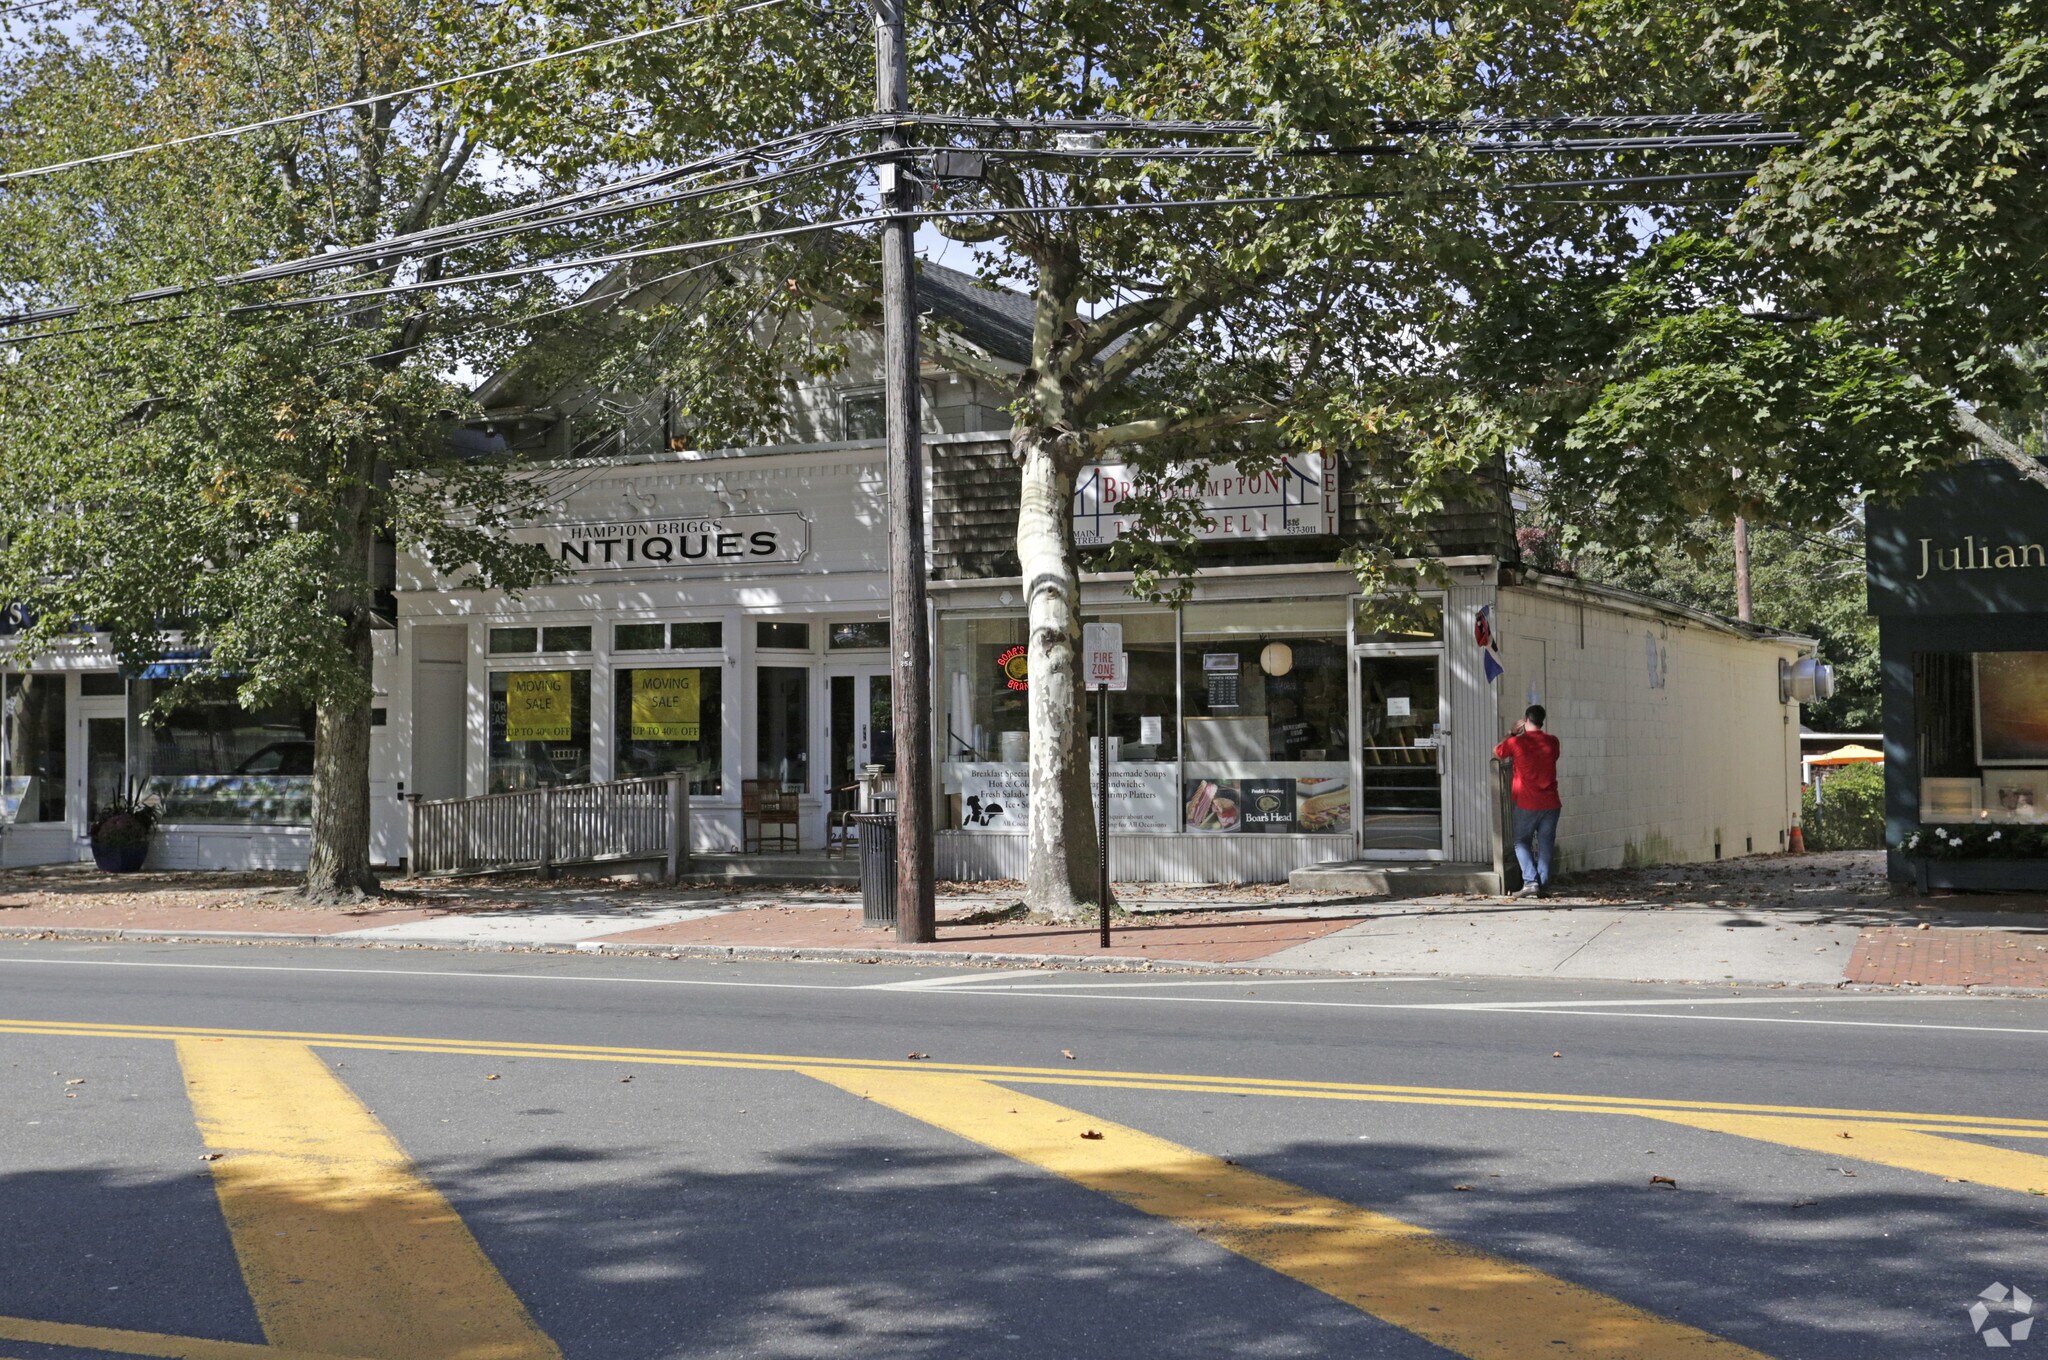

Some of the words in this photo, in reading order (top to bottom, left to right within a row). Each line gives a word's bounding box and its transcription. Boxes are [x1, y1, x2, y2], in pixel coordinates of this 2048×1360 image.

[1323, 453, 1336, 535] DELI
[571, 521, 648, 539] HAMPTON
[657, 520, 722, 535] BRIGGS
[1205, 514, 1268, 534] DELI
[1286, 526, 1317, 535] 537-3011
[1916, 535, 2047, 580] Julian
[1093, 652, 1113, 663] FIRE
[1092, 664, 1115, 675] ZONE
[516, 680, 561, 692] MOVING
[642, 678, 689, 690] MOVING
[1007, 680, 1029, 691] BRAN
[525, 699, 551, 710] SALE
[652, 696, 679, 707] SALE
[507, 728, 520, 736] UP
[521, 728, 534, 736] TO
[553, 727, 571, 736] OFF
[632, 727, 645, 735] UP
[646, 727, 659, 735] TO
[681, 727, 699, 735] OFF
[971, 769, 1003, 778] Breakfast
[1108, 769, 1142, 778] omemade
[1144, 769, 1167, 780] Soups
[988, 780, 1003, 788] Hot
[981, 790, 1000, 798] Fresh
[1002, 790, 1025, 798] Salads
[1129, 791, 1156, 799] Platters
[1245, 812, 1269, 822] Boar's
[1270, 812, 1292, 822] Head
